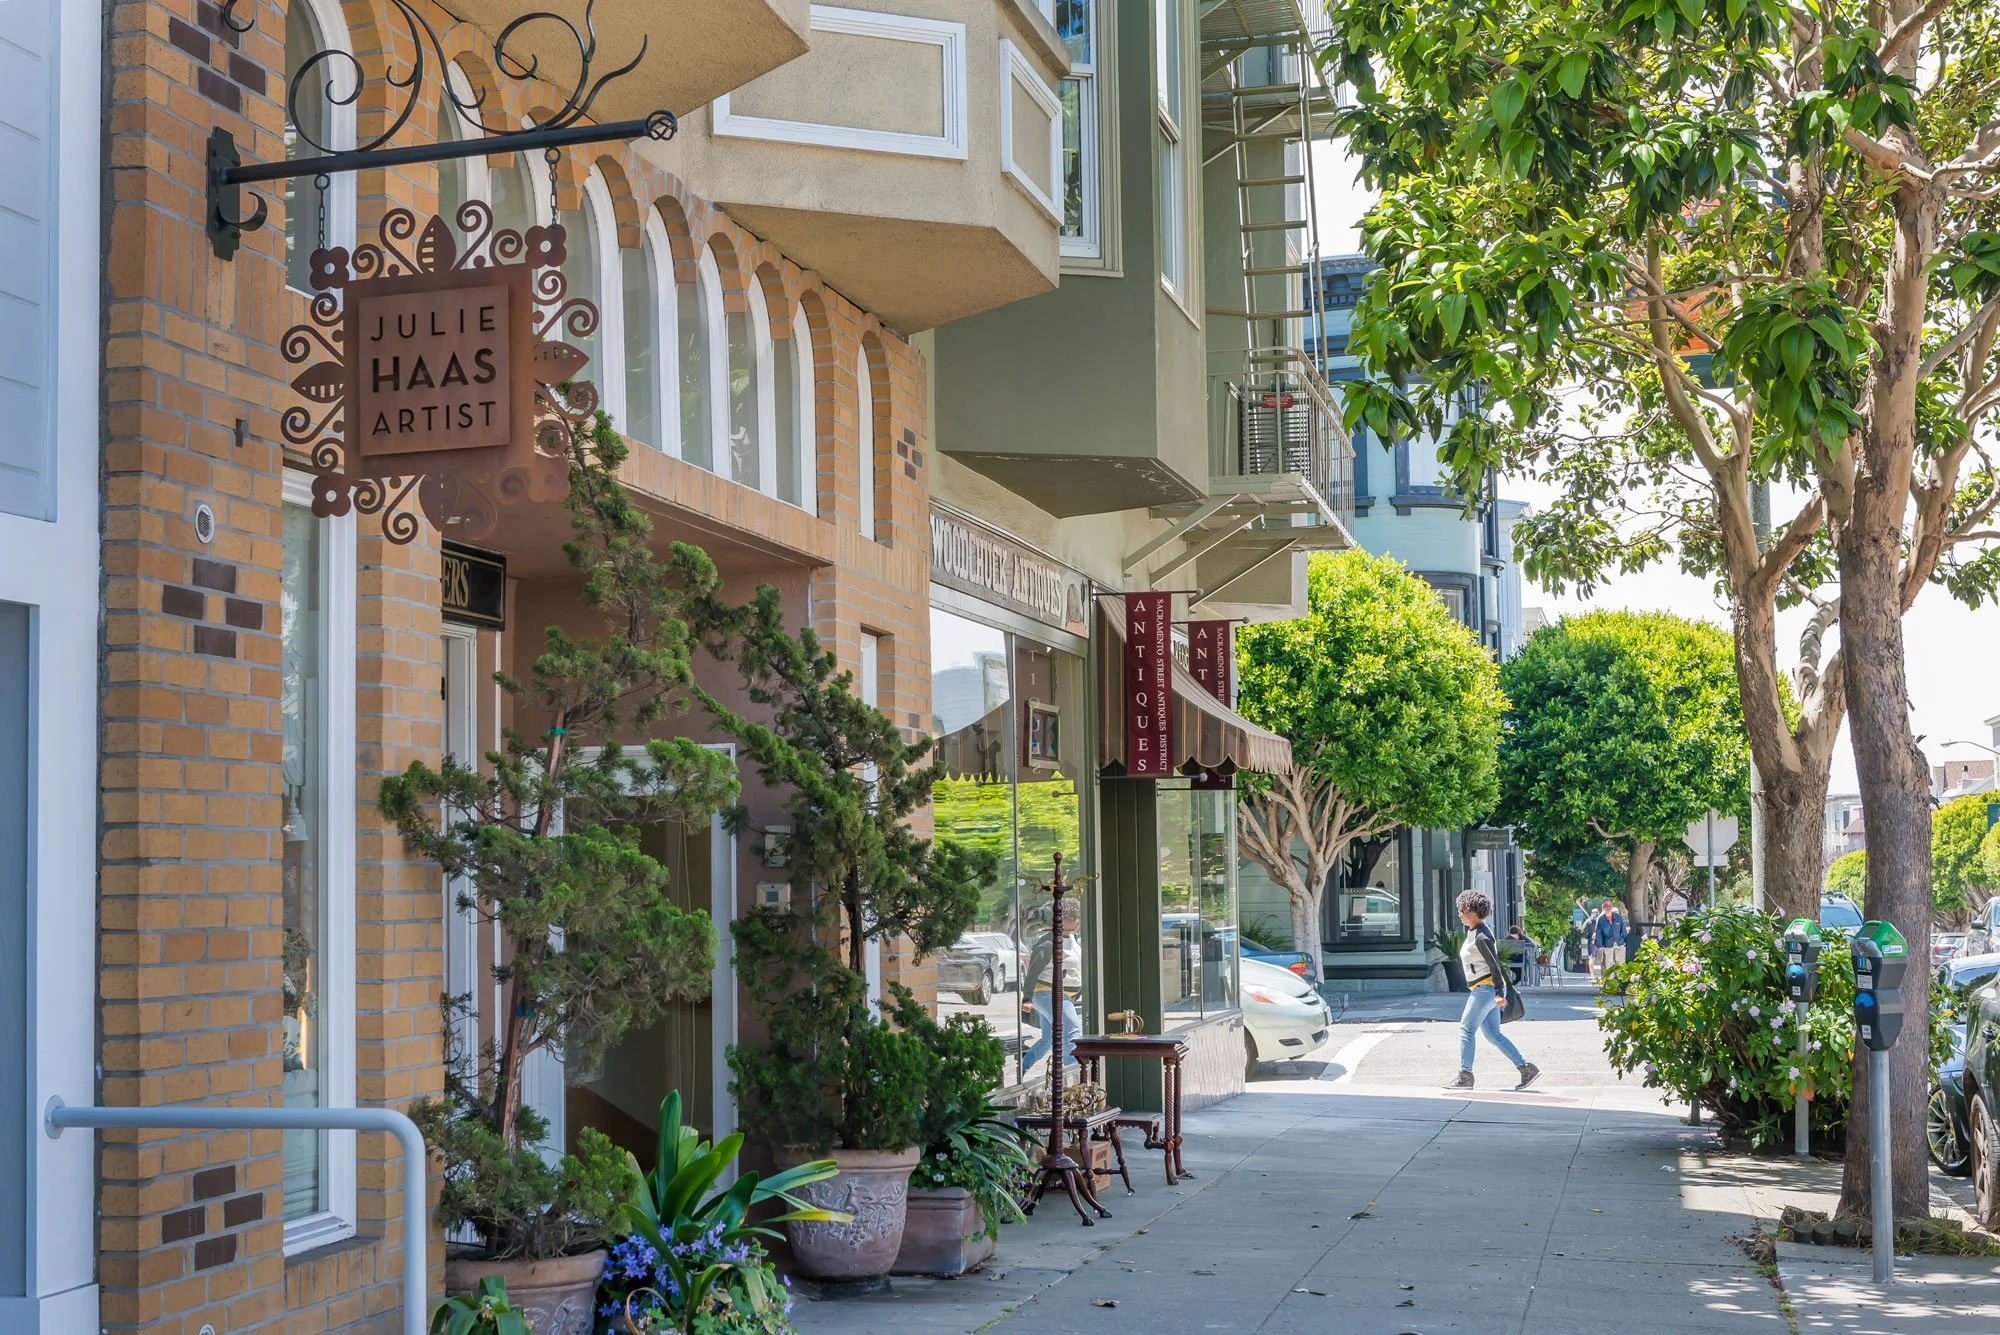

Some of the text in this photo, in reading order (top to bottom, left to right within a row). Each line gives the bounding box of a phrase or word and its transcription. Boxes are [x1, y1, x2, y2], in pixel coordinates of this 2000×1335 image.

[371, 306, 495, 342] JULIE
[372, 348, 497, 393] HAAS
[372, 401, 496, 436] ARTIST
[929, 513, 1061, 618] WOODCHUCK ANTIQUES
[1216, 627, 1225, 678] SACRAMENTO
[1134, 599, 1149, 772] ANTIQUES
[1156, 598, 1168, 772] SACRAMENTO STREET ANTIQUES DISTRICT
